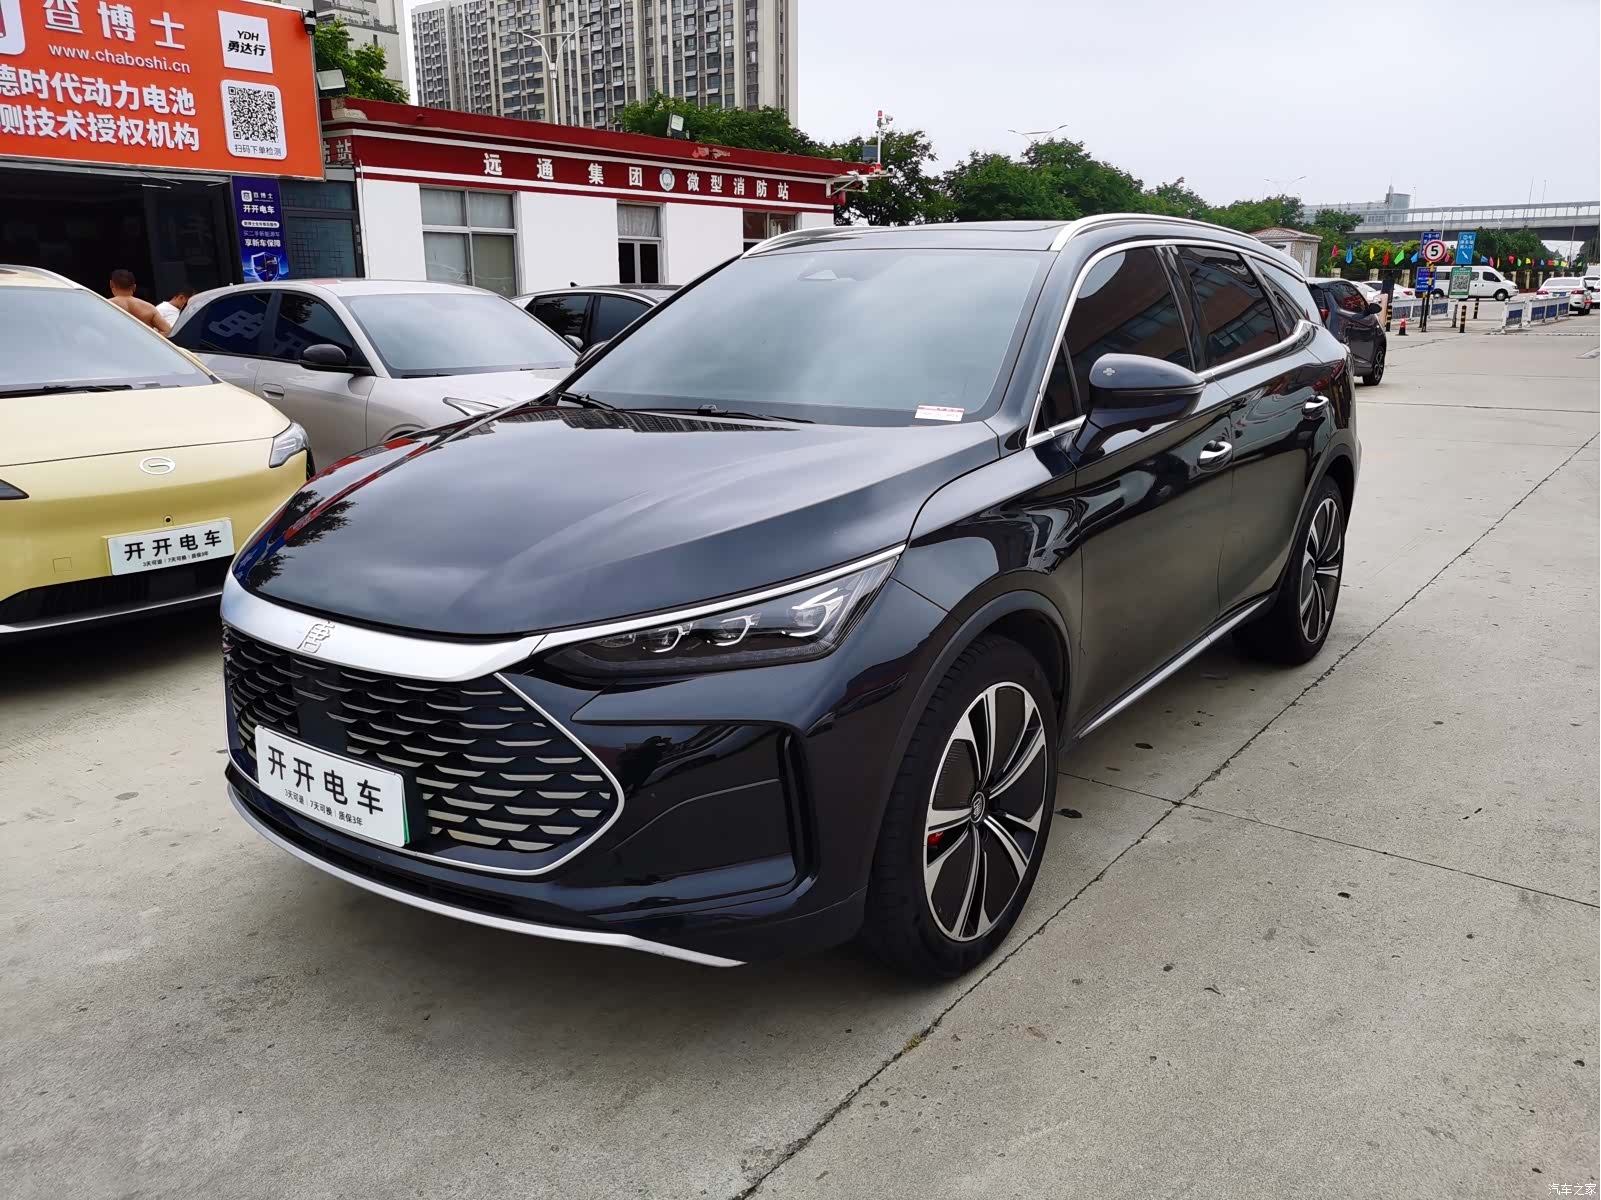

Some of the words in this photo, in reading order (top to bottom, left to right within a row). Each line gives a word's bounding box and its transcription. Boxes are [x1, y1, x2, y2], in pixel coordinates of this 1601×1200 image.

[43, 0, 186, 50] 查博士
[237, 30, 260, 41] YDH
[48, 44, 191, 73] www.chaboshi.cn
[228, 40, 266, 56] 勇达行
[234, 144, 282, 156] 扫码下单检测
[483, 153, 643, 187] 远通集团
[687, 172, 789, 200] 微型消防站
[243, 204, 275, 214] 开开电车
[1430, 245, 1439, 257] 5
[124, 530, 222, 561] 开开电车
[266, 745, 384, 815] 开开电车
